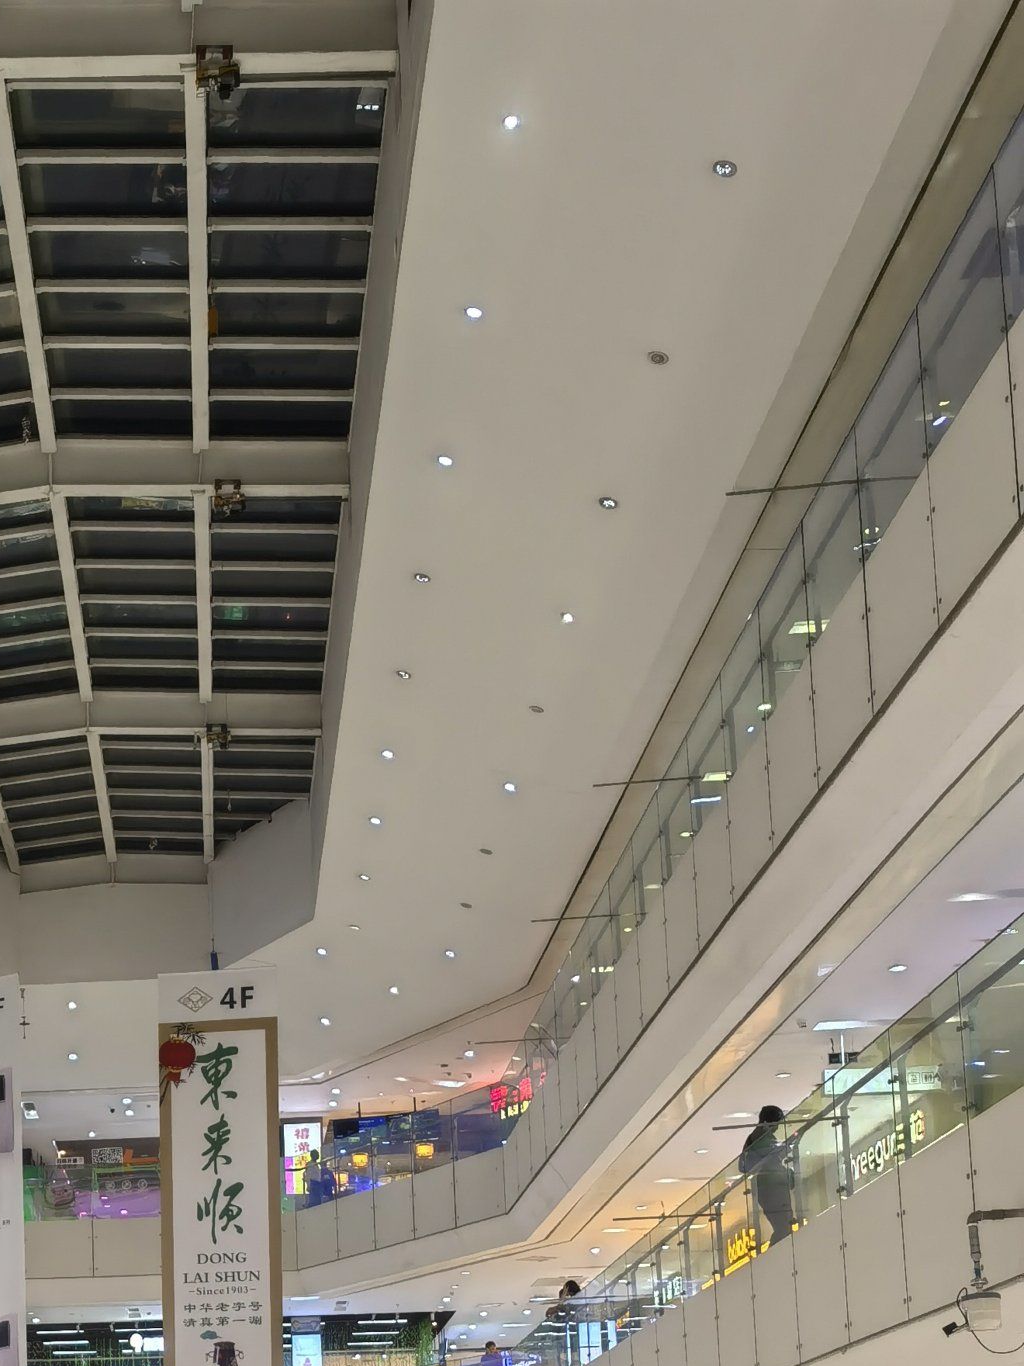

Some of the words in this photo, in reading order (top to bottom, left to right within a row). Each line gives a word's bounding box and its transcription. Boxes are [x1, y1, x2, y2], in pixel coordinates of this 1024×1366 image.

[219, 985, 255, 1010] 4F
[196, 1252, 247, 1265] DONG
[183, 1271, 209, 1284] LAI
[214, 1269, 261, 1283] SHUN
[183, 1301, 263, 1313] 中华老字号
